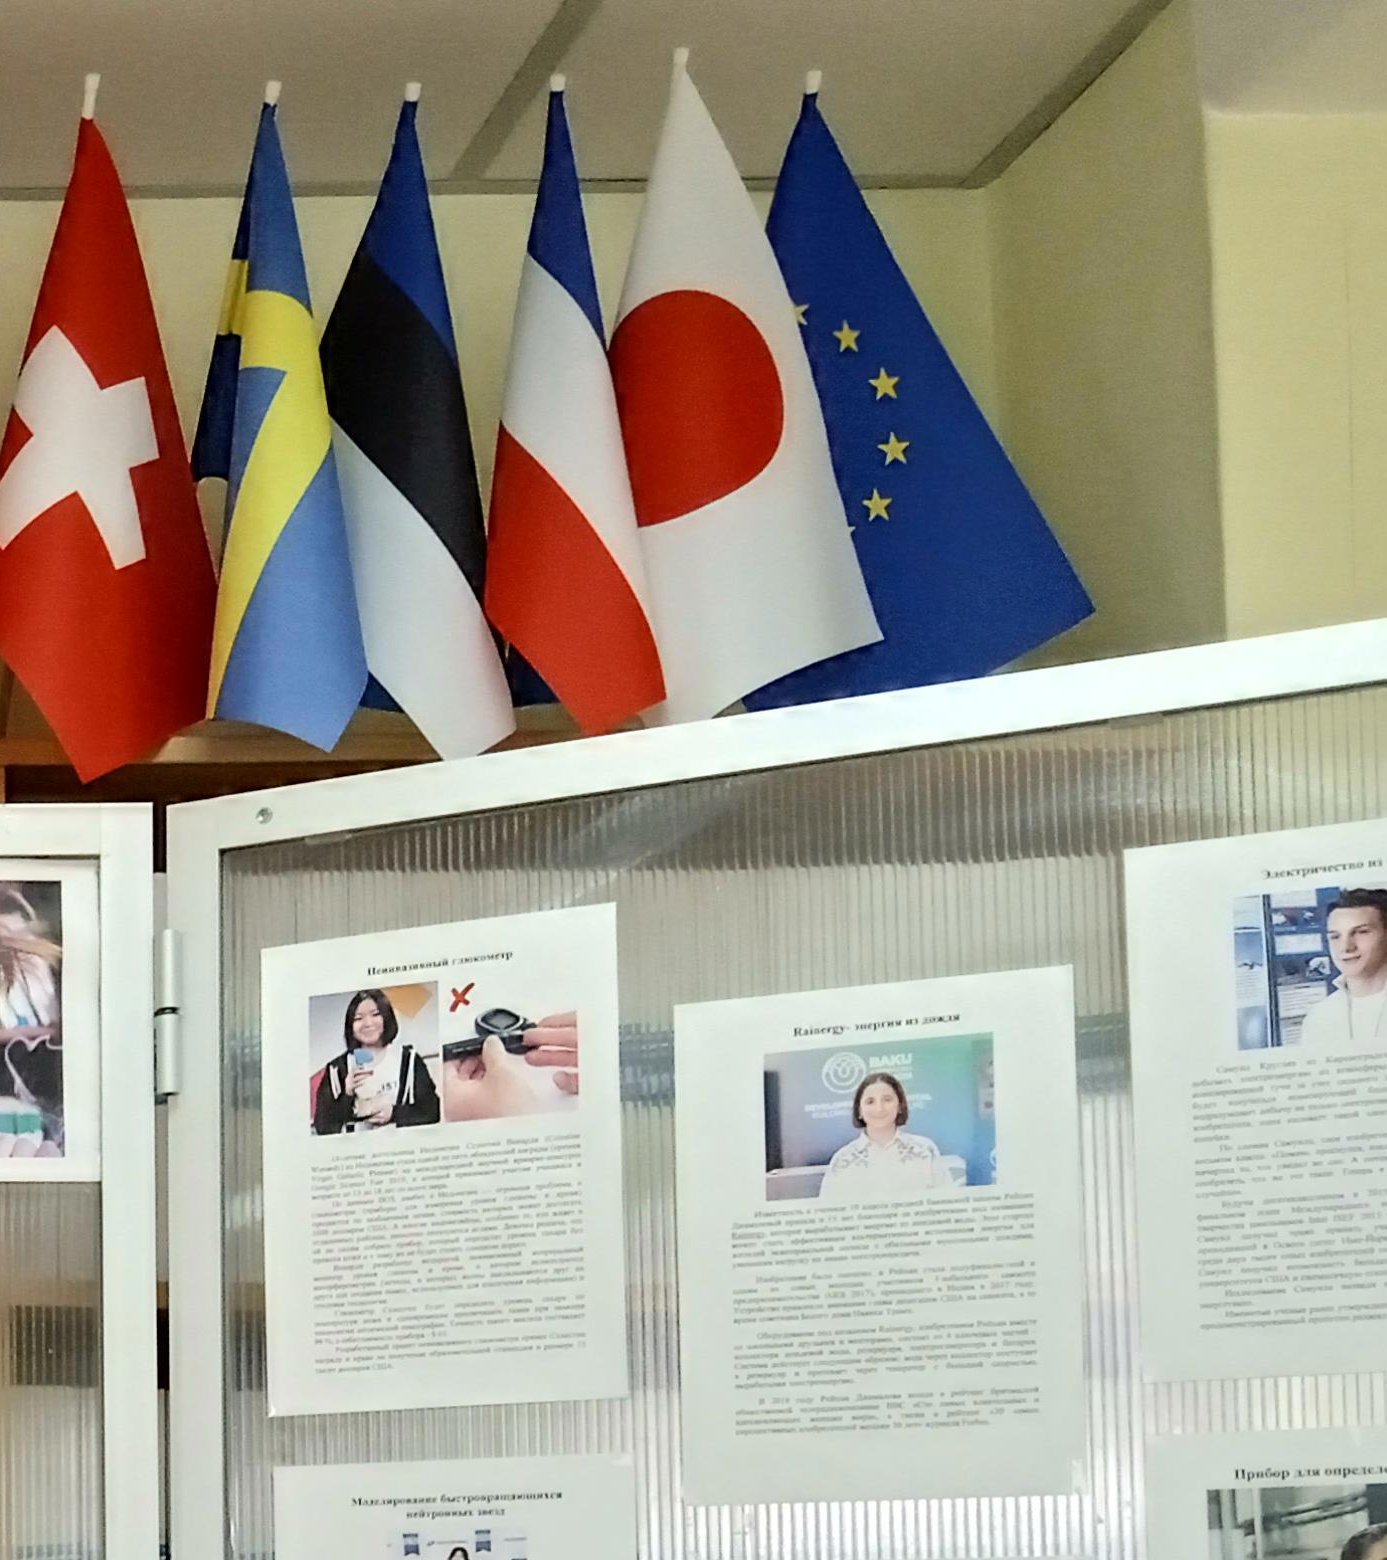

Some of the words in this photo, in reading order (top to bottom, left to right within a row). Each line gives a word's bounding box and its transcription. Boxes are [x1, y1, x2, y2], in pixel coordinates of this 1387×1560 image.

[869, 1053, 913, 1067] BAKU
[1235, 1468, 1290, 1481] Прибор
[1295, 1469, 1320, 1477] для
